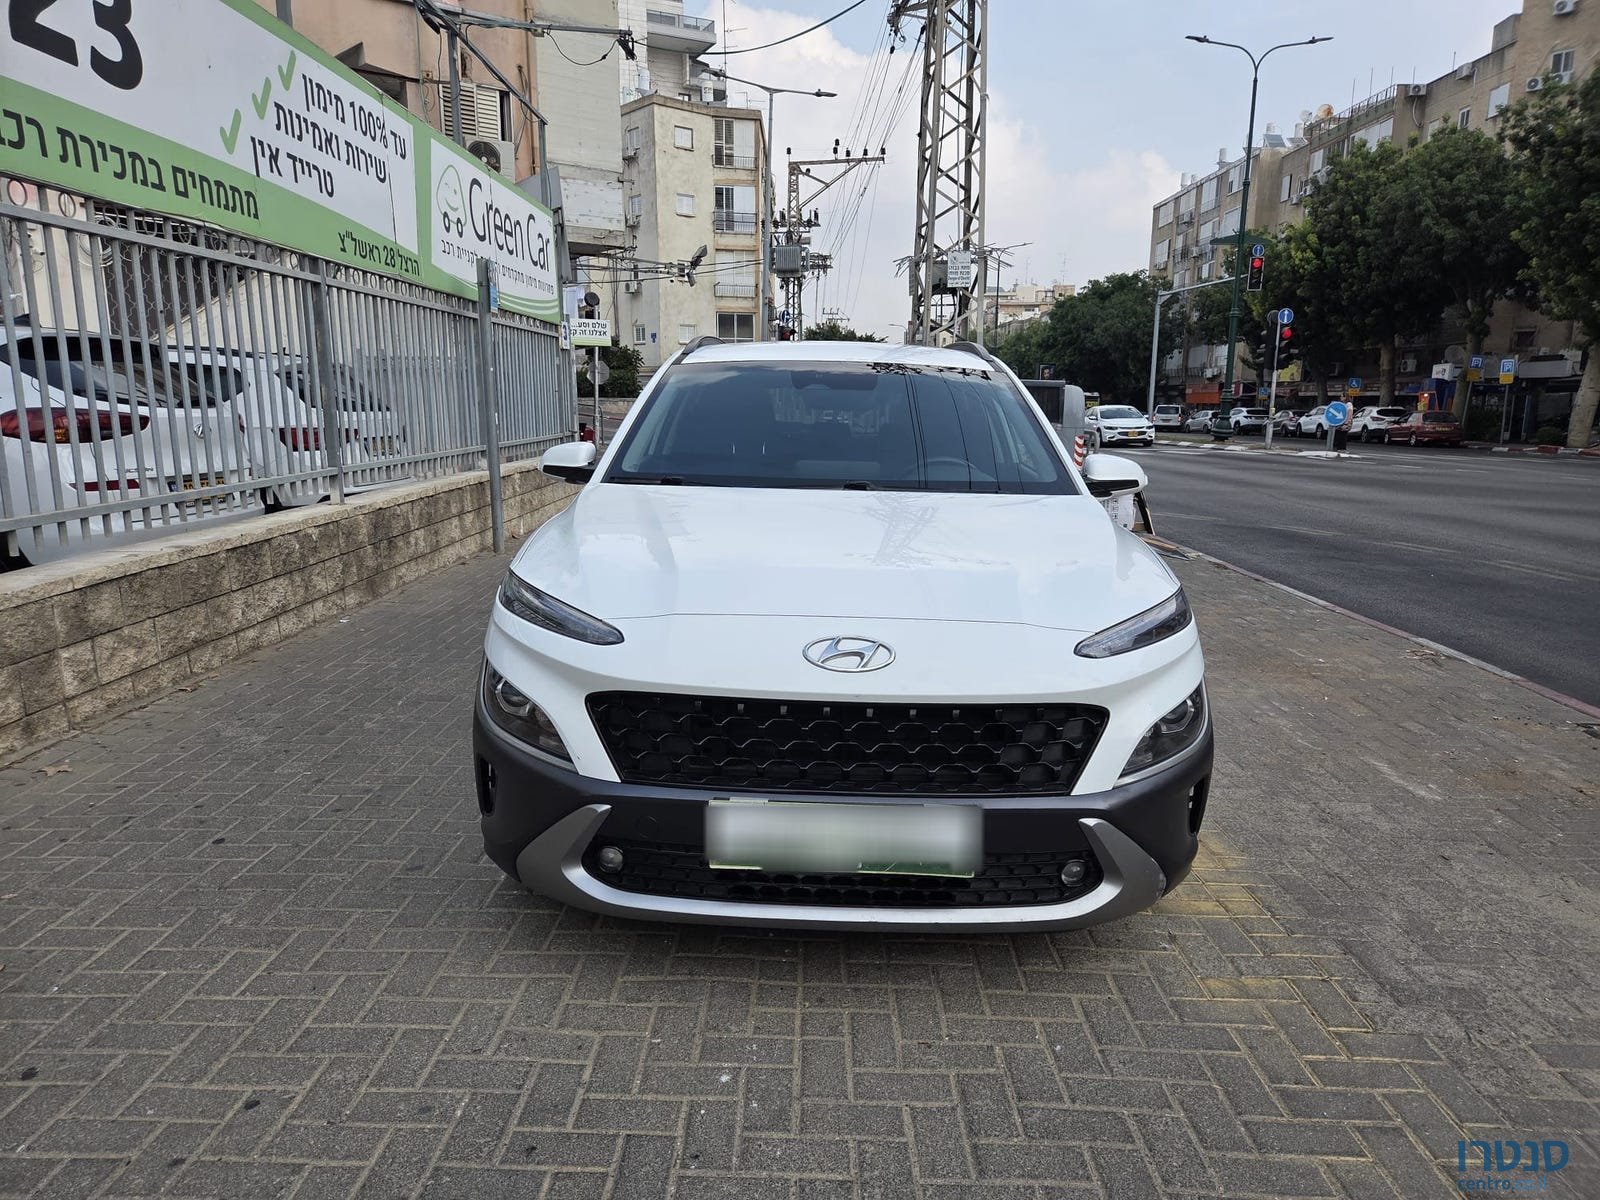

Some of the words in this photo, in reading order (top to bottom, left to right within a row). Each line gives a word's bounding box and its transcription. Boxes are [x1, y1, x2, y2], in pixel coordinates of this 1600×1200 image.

[302, 73, 346, 124] מימון
[0, 108, 49, 159] רכ
[274, 101, 341, 161] ואמינות
[350, 101, 388, 149] 100%
[389, 129, 407, 160] עד
[56, 126, 167, 193] במכירת
[250, 135, 283, 178] אין
[286, 151, 335, 198] טרייד
[345, 139, 387, 184] שירות
[171, 164, 260, 220] מתמחים
[441, 239, 455, 257] רכב
[469, 177, 525, 261] Green
[526, 213, 550, 273] Car
[382, 244, 396, 268] 28
[397, 248, 420, 277] הרצל
[591, 321, 607, 329] שלם
